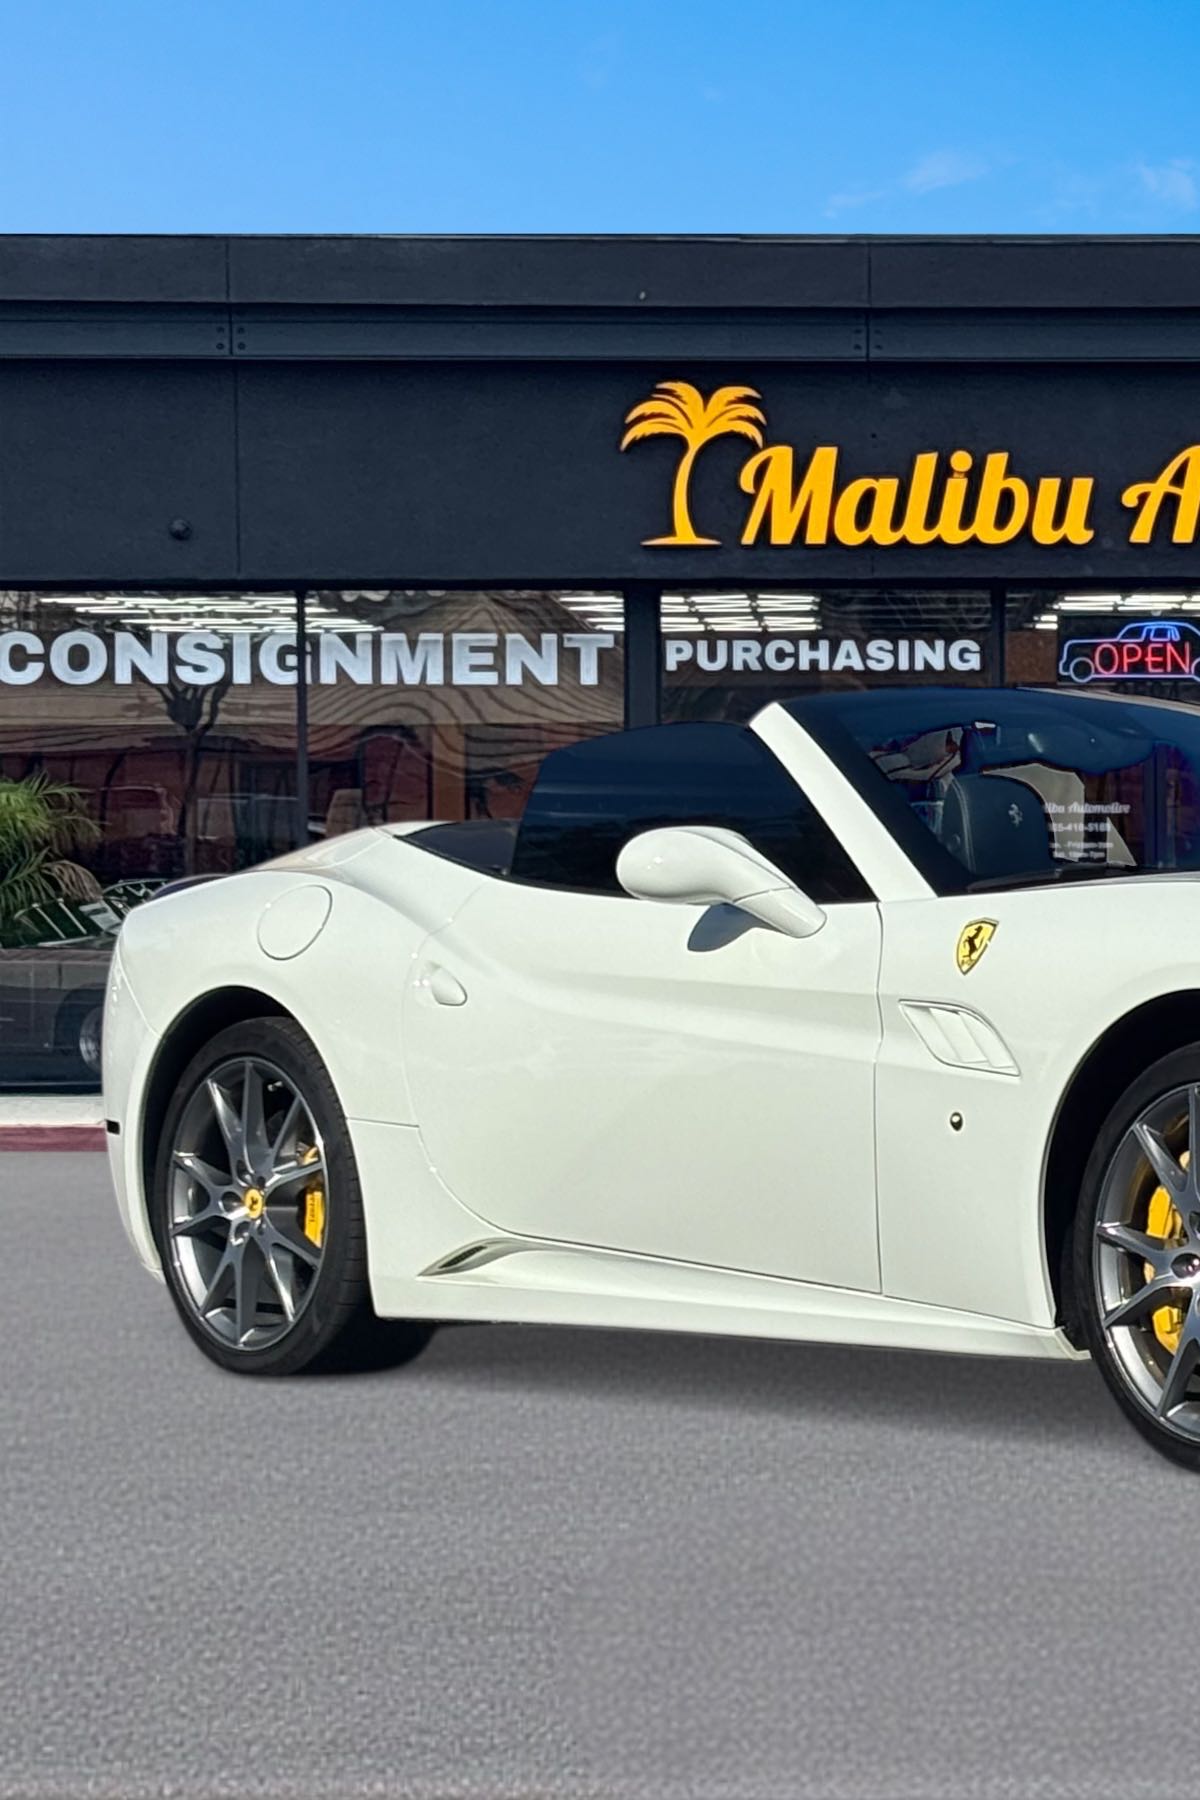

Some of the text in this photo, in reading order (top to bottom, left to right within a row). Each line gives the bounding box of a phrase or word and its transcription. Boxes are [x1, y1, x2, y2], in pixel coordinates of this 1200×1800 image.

[740, 445, 1095, 546] Malibu
[0, 630, 615, 686] CONSIGNMENT
[665, 638, 982, 672] PURCHASING
[1094, 641, 1191, 675] OPEN
